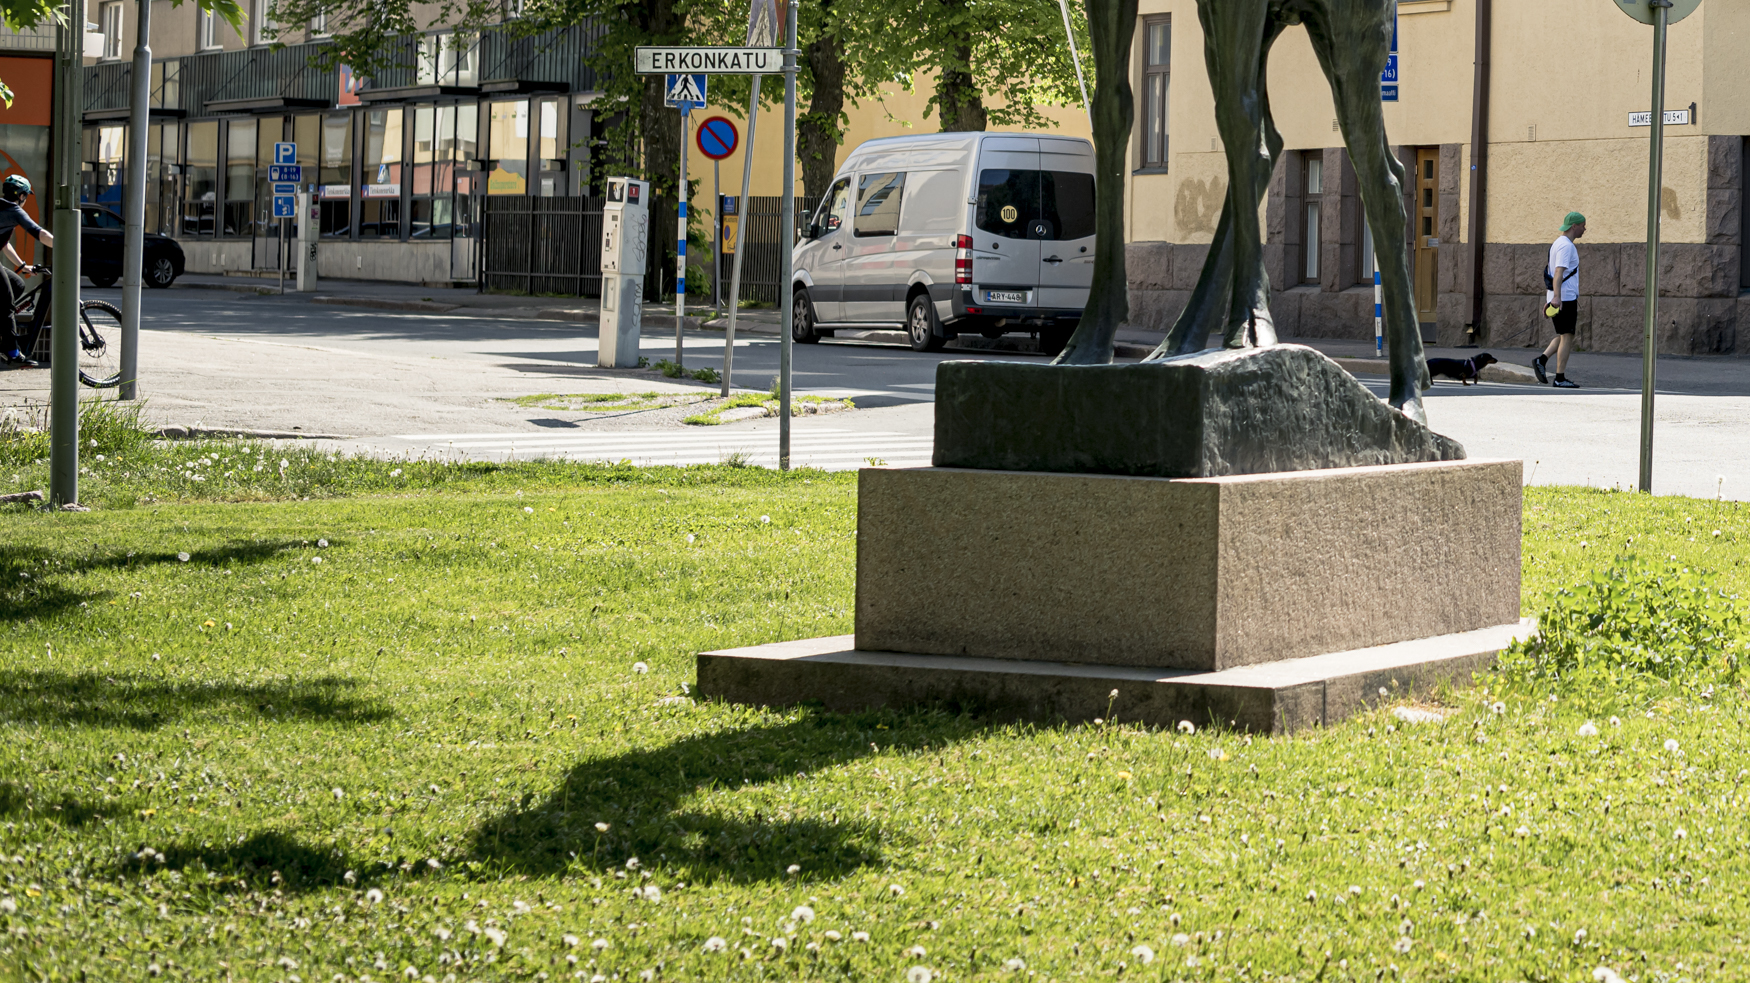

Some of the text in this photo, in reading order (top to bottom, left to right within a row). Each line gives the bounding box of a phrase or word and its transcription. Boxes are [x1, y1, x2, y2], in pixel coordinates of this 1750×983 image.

[652, 52, 767, 69] ERKONKATU
[1632, 112, 1672, 124] HÄMEETU
[279, 144, 294, 163] P
[1002, 208, 1016, 220] 100
[992, 292, 1021, 302] ARY-448
